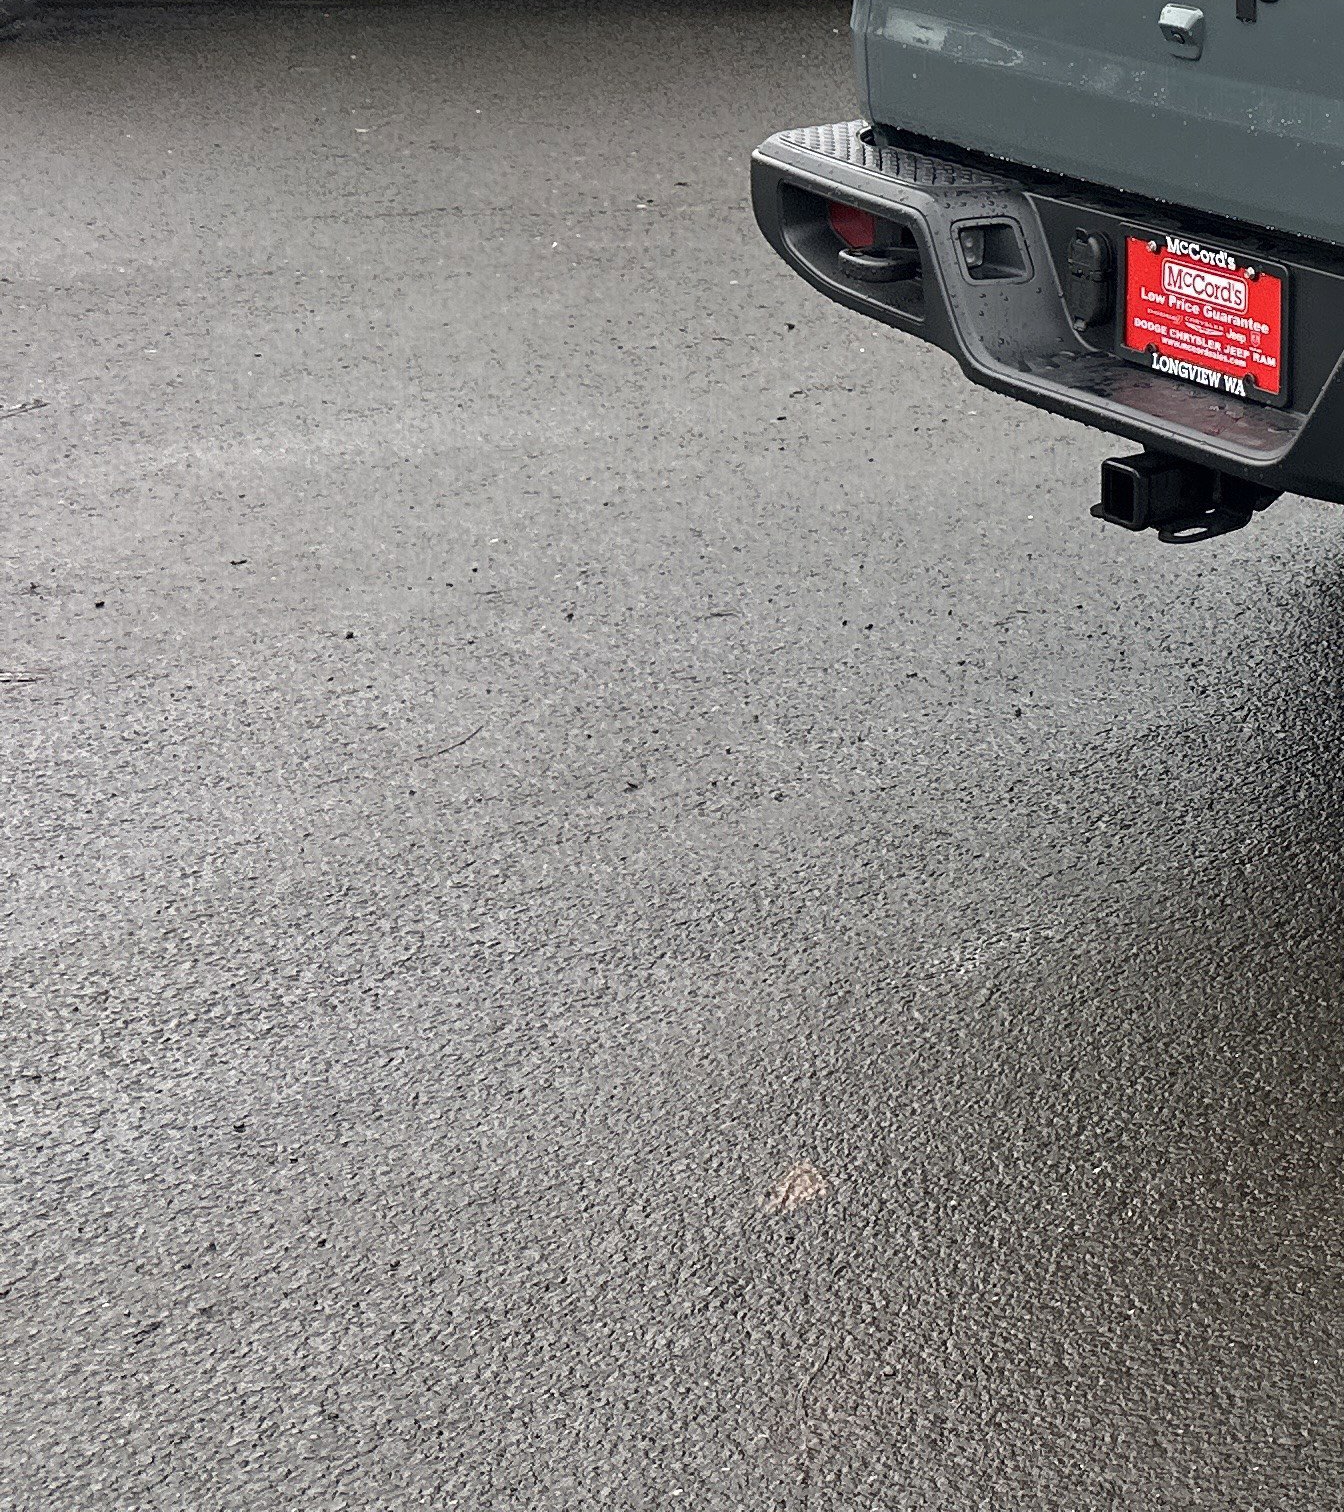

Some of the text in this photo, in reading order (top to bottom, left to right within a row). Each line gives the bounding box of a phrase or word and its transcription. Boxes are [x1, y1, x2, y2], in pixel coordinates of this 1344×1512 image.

[1165, 235, 1236, 271] McCord's
[1167, 265, 1242, 307] McCord's
[1140, 286, 1270, 335] Low Price Guarantee
[1133, 317, 1277, 368] DODGE CHRYSLER JEEP RAM
[1151, 352, 1246, 396] LONGVIEW WA
